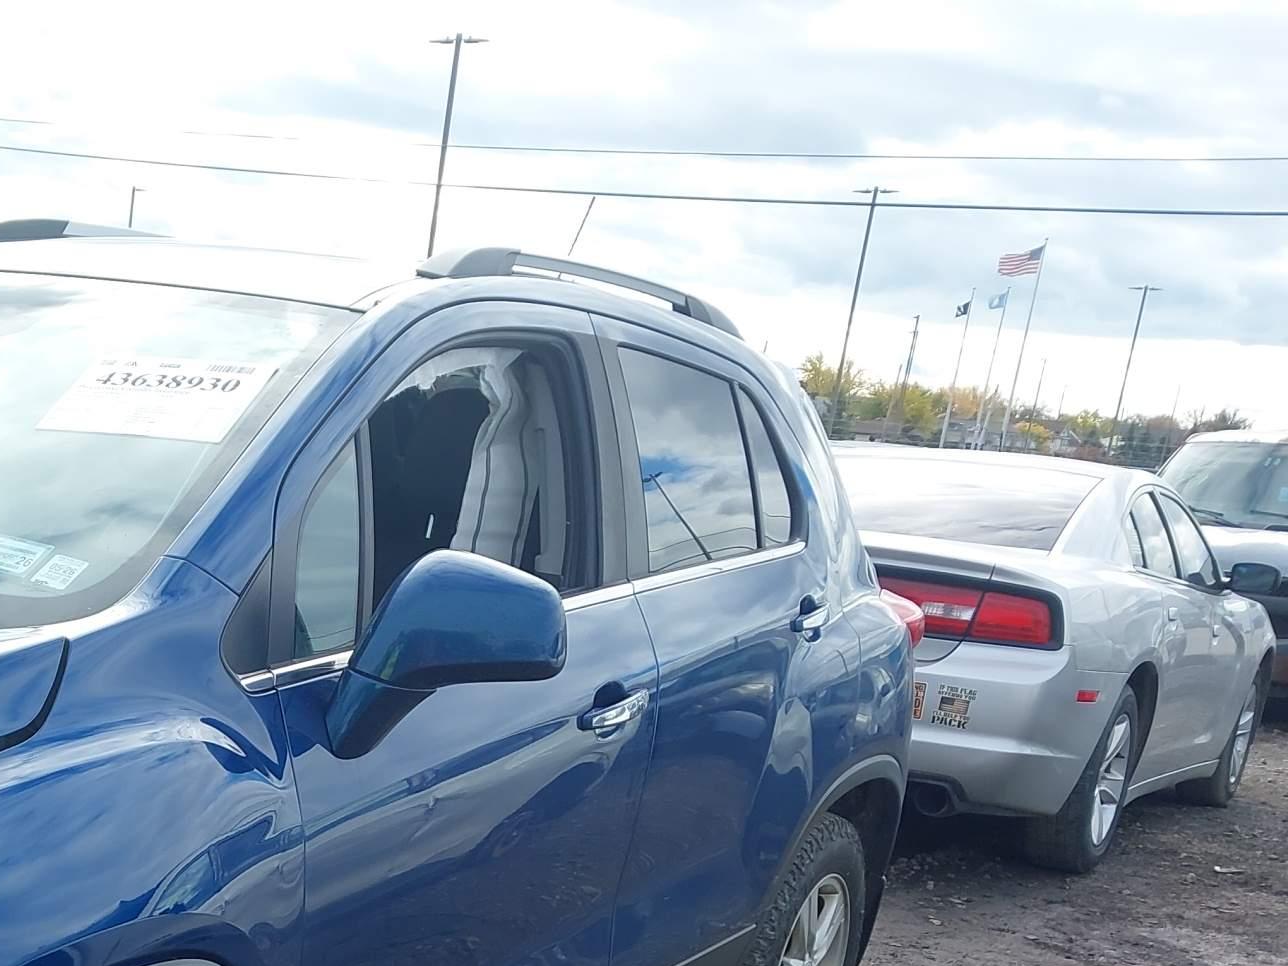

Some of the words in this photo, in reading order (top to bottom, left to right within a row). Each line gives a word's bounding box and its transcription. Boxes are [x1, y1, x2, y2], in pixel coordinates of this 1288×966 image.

[96, 371, 241, 393] 43638930
[960, 687, 977, 696] FLAG
[931, 715, 968, 729] PACK
